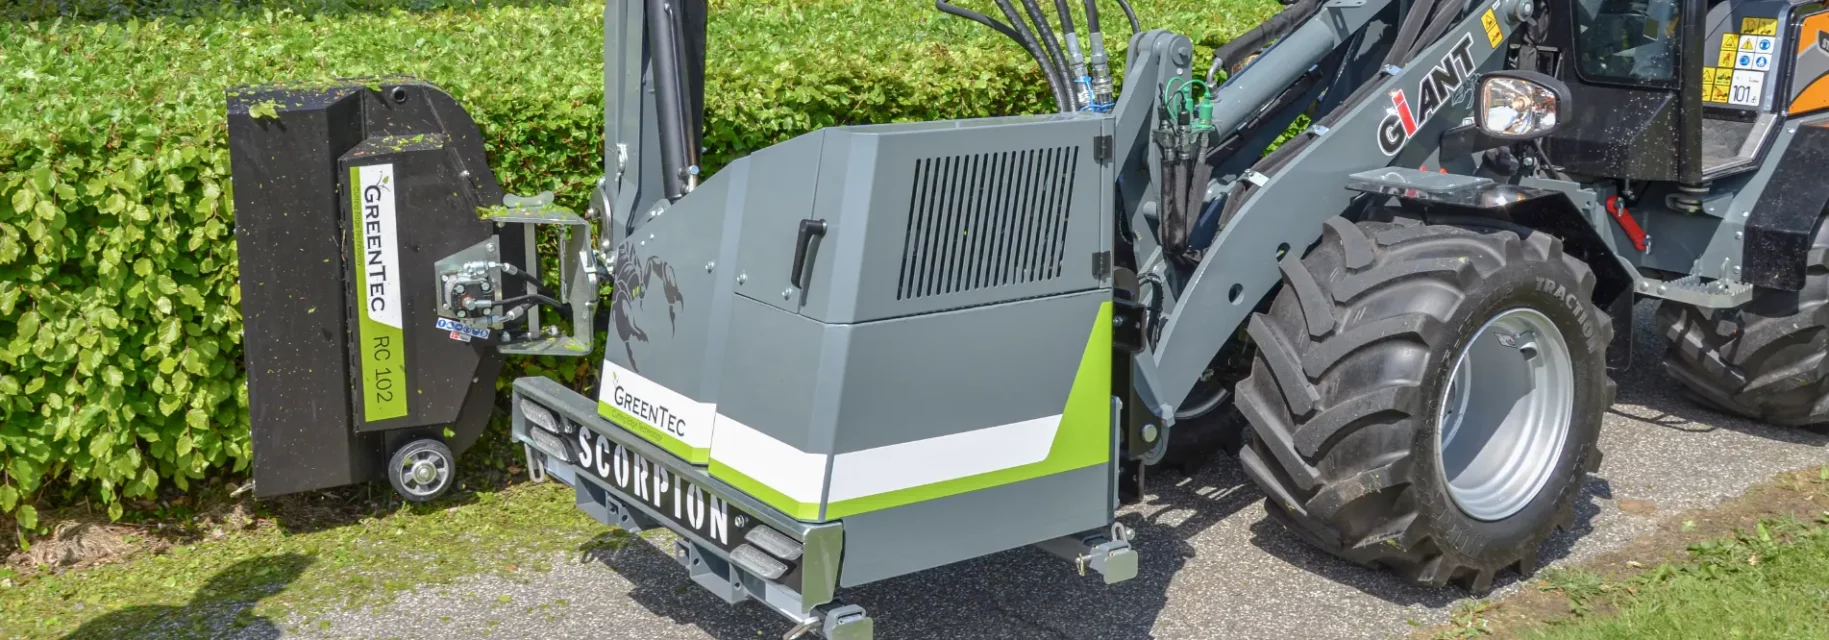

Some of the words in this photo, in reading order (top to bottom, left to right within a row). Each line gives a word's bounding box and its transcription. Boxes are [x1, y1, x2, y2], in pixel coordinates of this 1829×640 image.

[1733, 85, 1751, 103] 101
[364, 185, 387, 312] GREENTEC
[1535, 276, 1596, 354] TRACTION
[373, 336, 391, 361] RC
[375, 367, 394, 404] 102
[614, 385, 686, 437] GREENTEC
[578, 426, 728, 545] SCORPION
